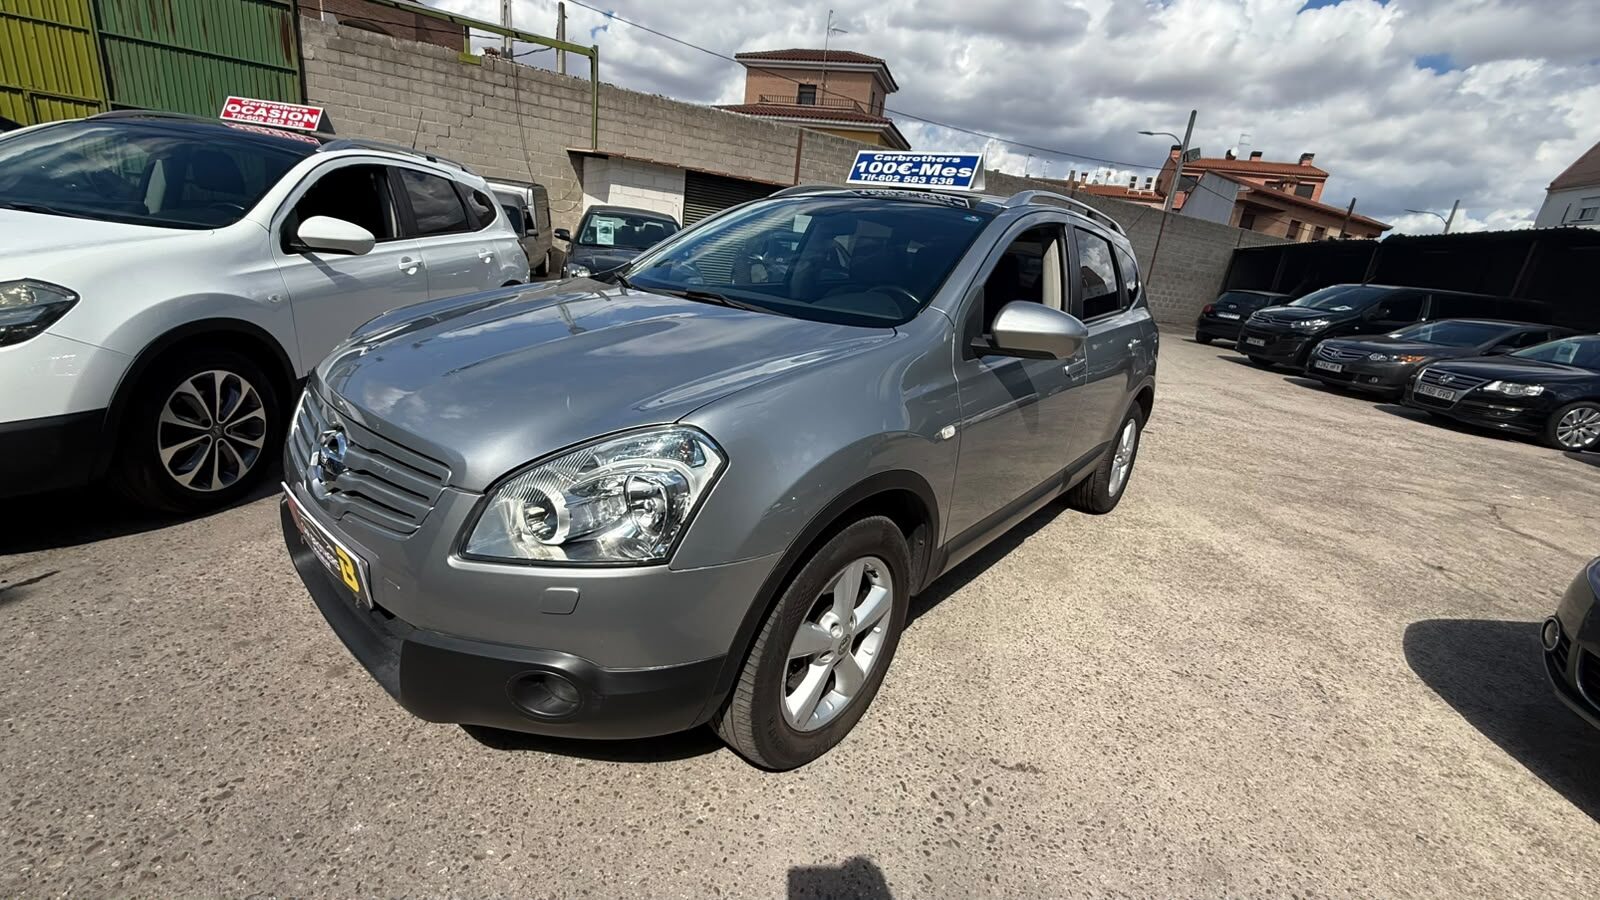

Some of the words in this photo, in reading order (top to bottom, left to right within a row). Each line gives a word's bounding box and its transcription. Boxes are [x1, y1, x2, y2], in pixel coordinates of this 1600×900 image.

[241, 100, 309, 113] Carbrothers
[226, 104, 318, 123] OCASION
[266, 117, 285, 125] 583
[873, 154, 961, 163] Carbrothers
[856, 161, 973, 178] 100€-Mes
[903, 175, 926, 184] 583
[930, 177, 955, 185] 538
